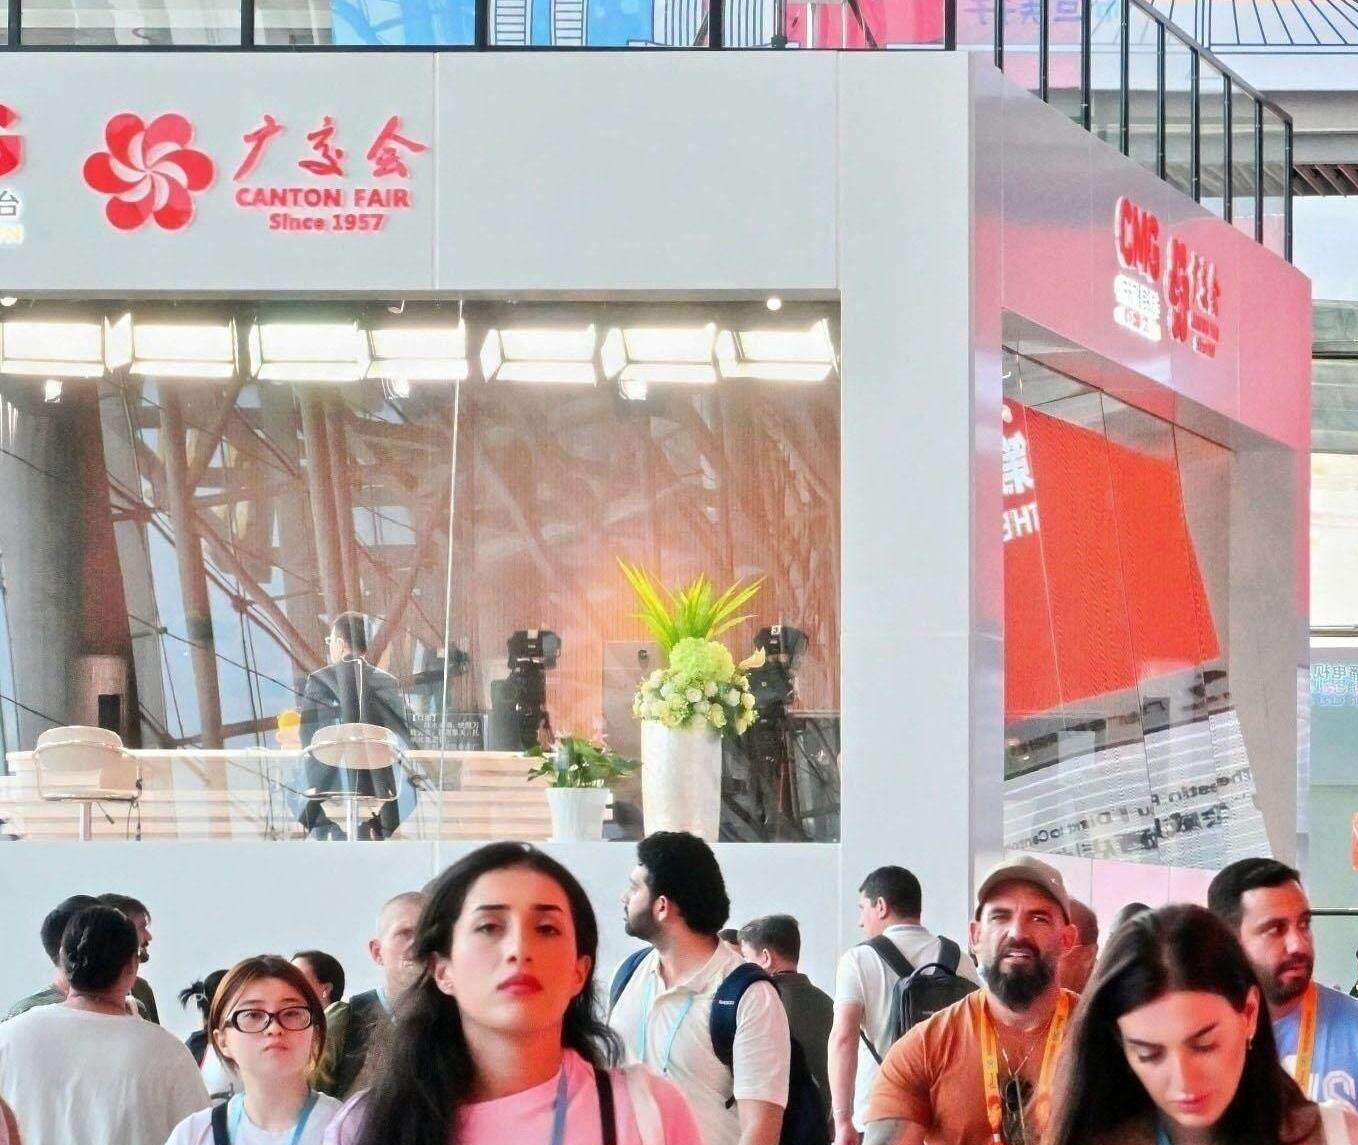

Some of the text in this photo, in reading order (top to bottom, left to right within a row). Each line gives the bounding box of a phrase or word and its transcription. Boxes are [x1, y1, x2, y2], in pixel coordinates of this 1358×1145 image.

[235, 187, 411, 208] CANTON FAIR
[269, 213, 385, 232] Since 1957
